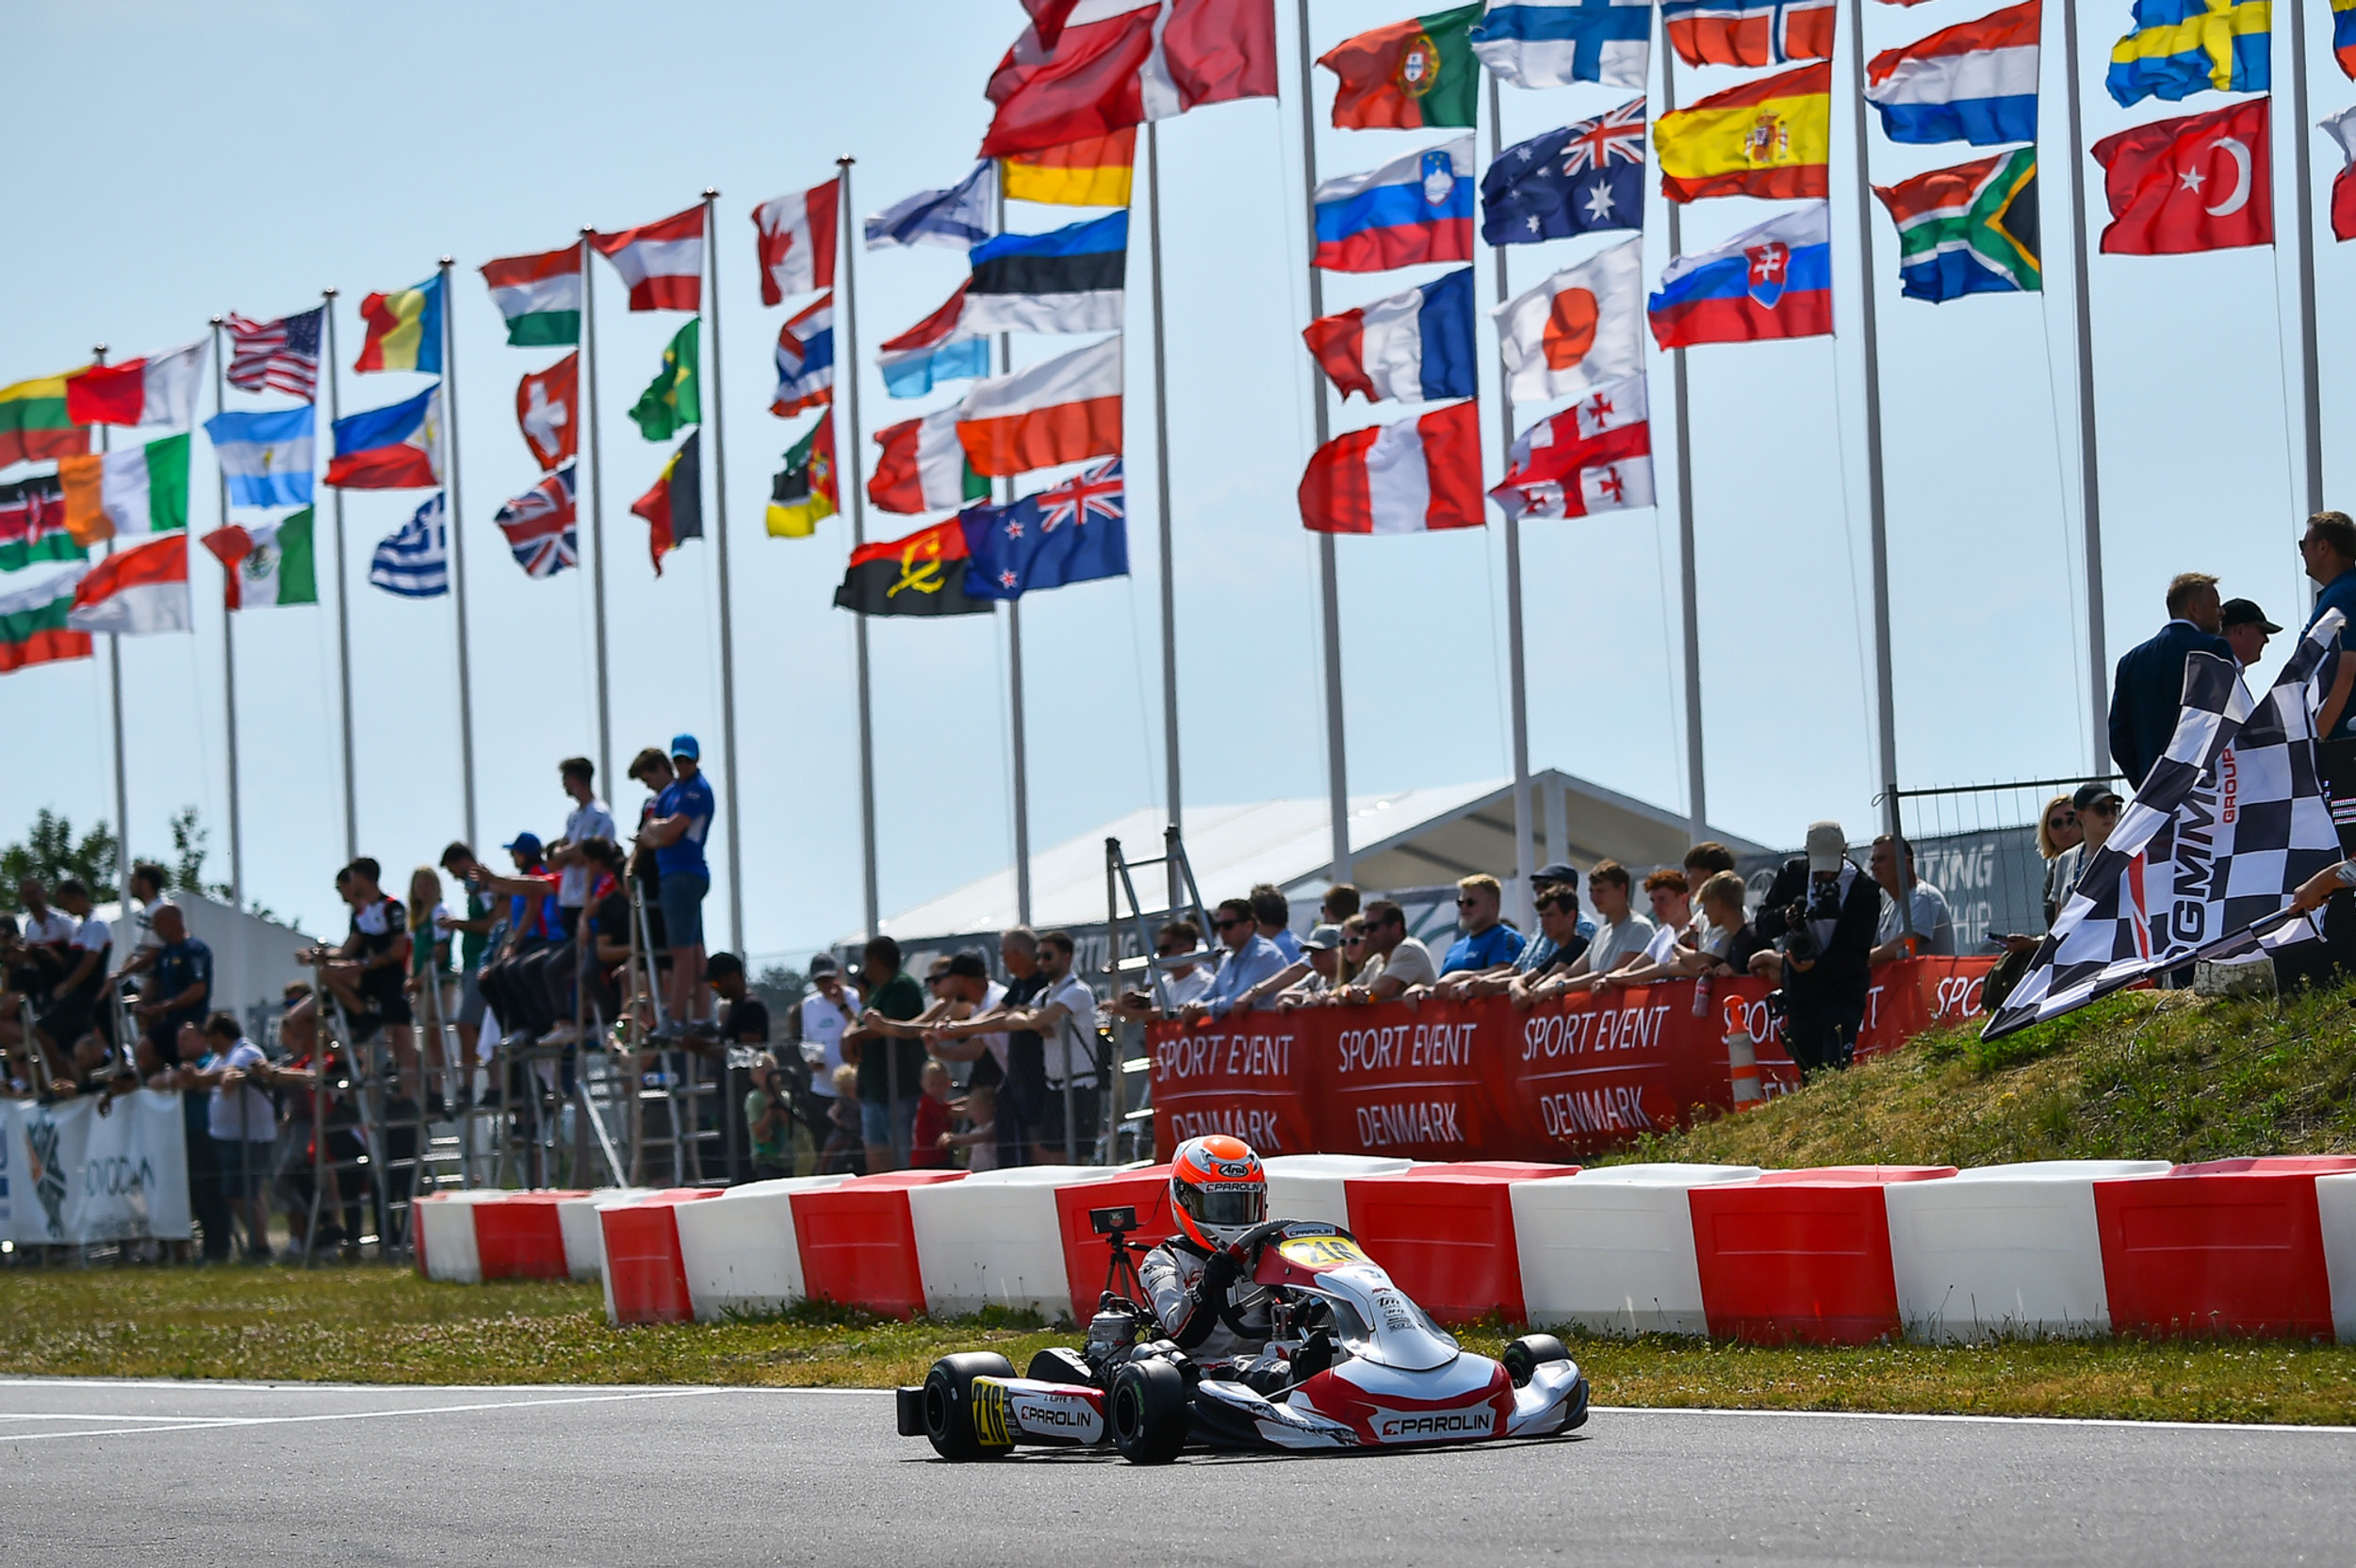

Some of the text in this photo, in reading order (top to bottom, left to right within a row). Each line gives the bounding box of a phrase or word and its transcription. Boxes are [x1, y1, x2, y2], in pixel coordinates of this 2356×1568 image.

[2222, 747, 2237, 824] GROUP
[1932, 976, 1986, 1019] SPO
[1338, 1022, 1477, 1072] SPORT EVENT
[1522, 1005, 1671, 1061] SPORT EVENT
[1156, 1035, 1294, 1083] SPORT EVENT
[1170, 1108, 1281, 1150] DENMARK
[1356, 1102, 1464, 1147] DENMARK
[1540, 1086, 1650, 1136] DENMARK
[1221, 1165, 1246, 1174] Arai
